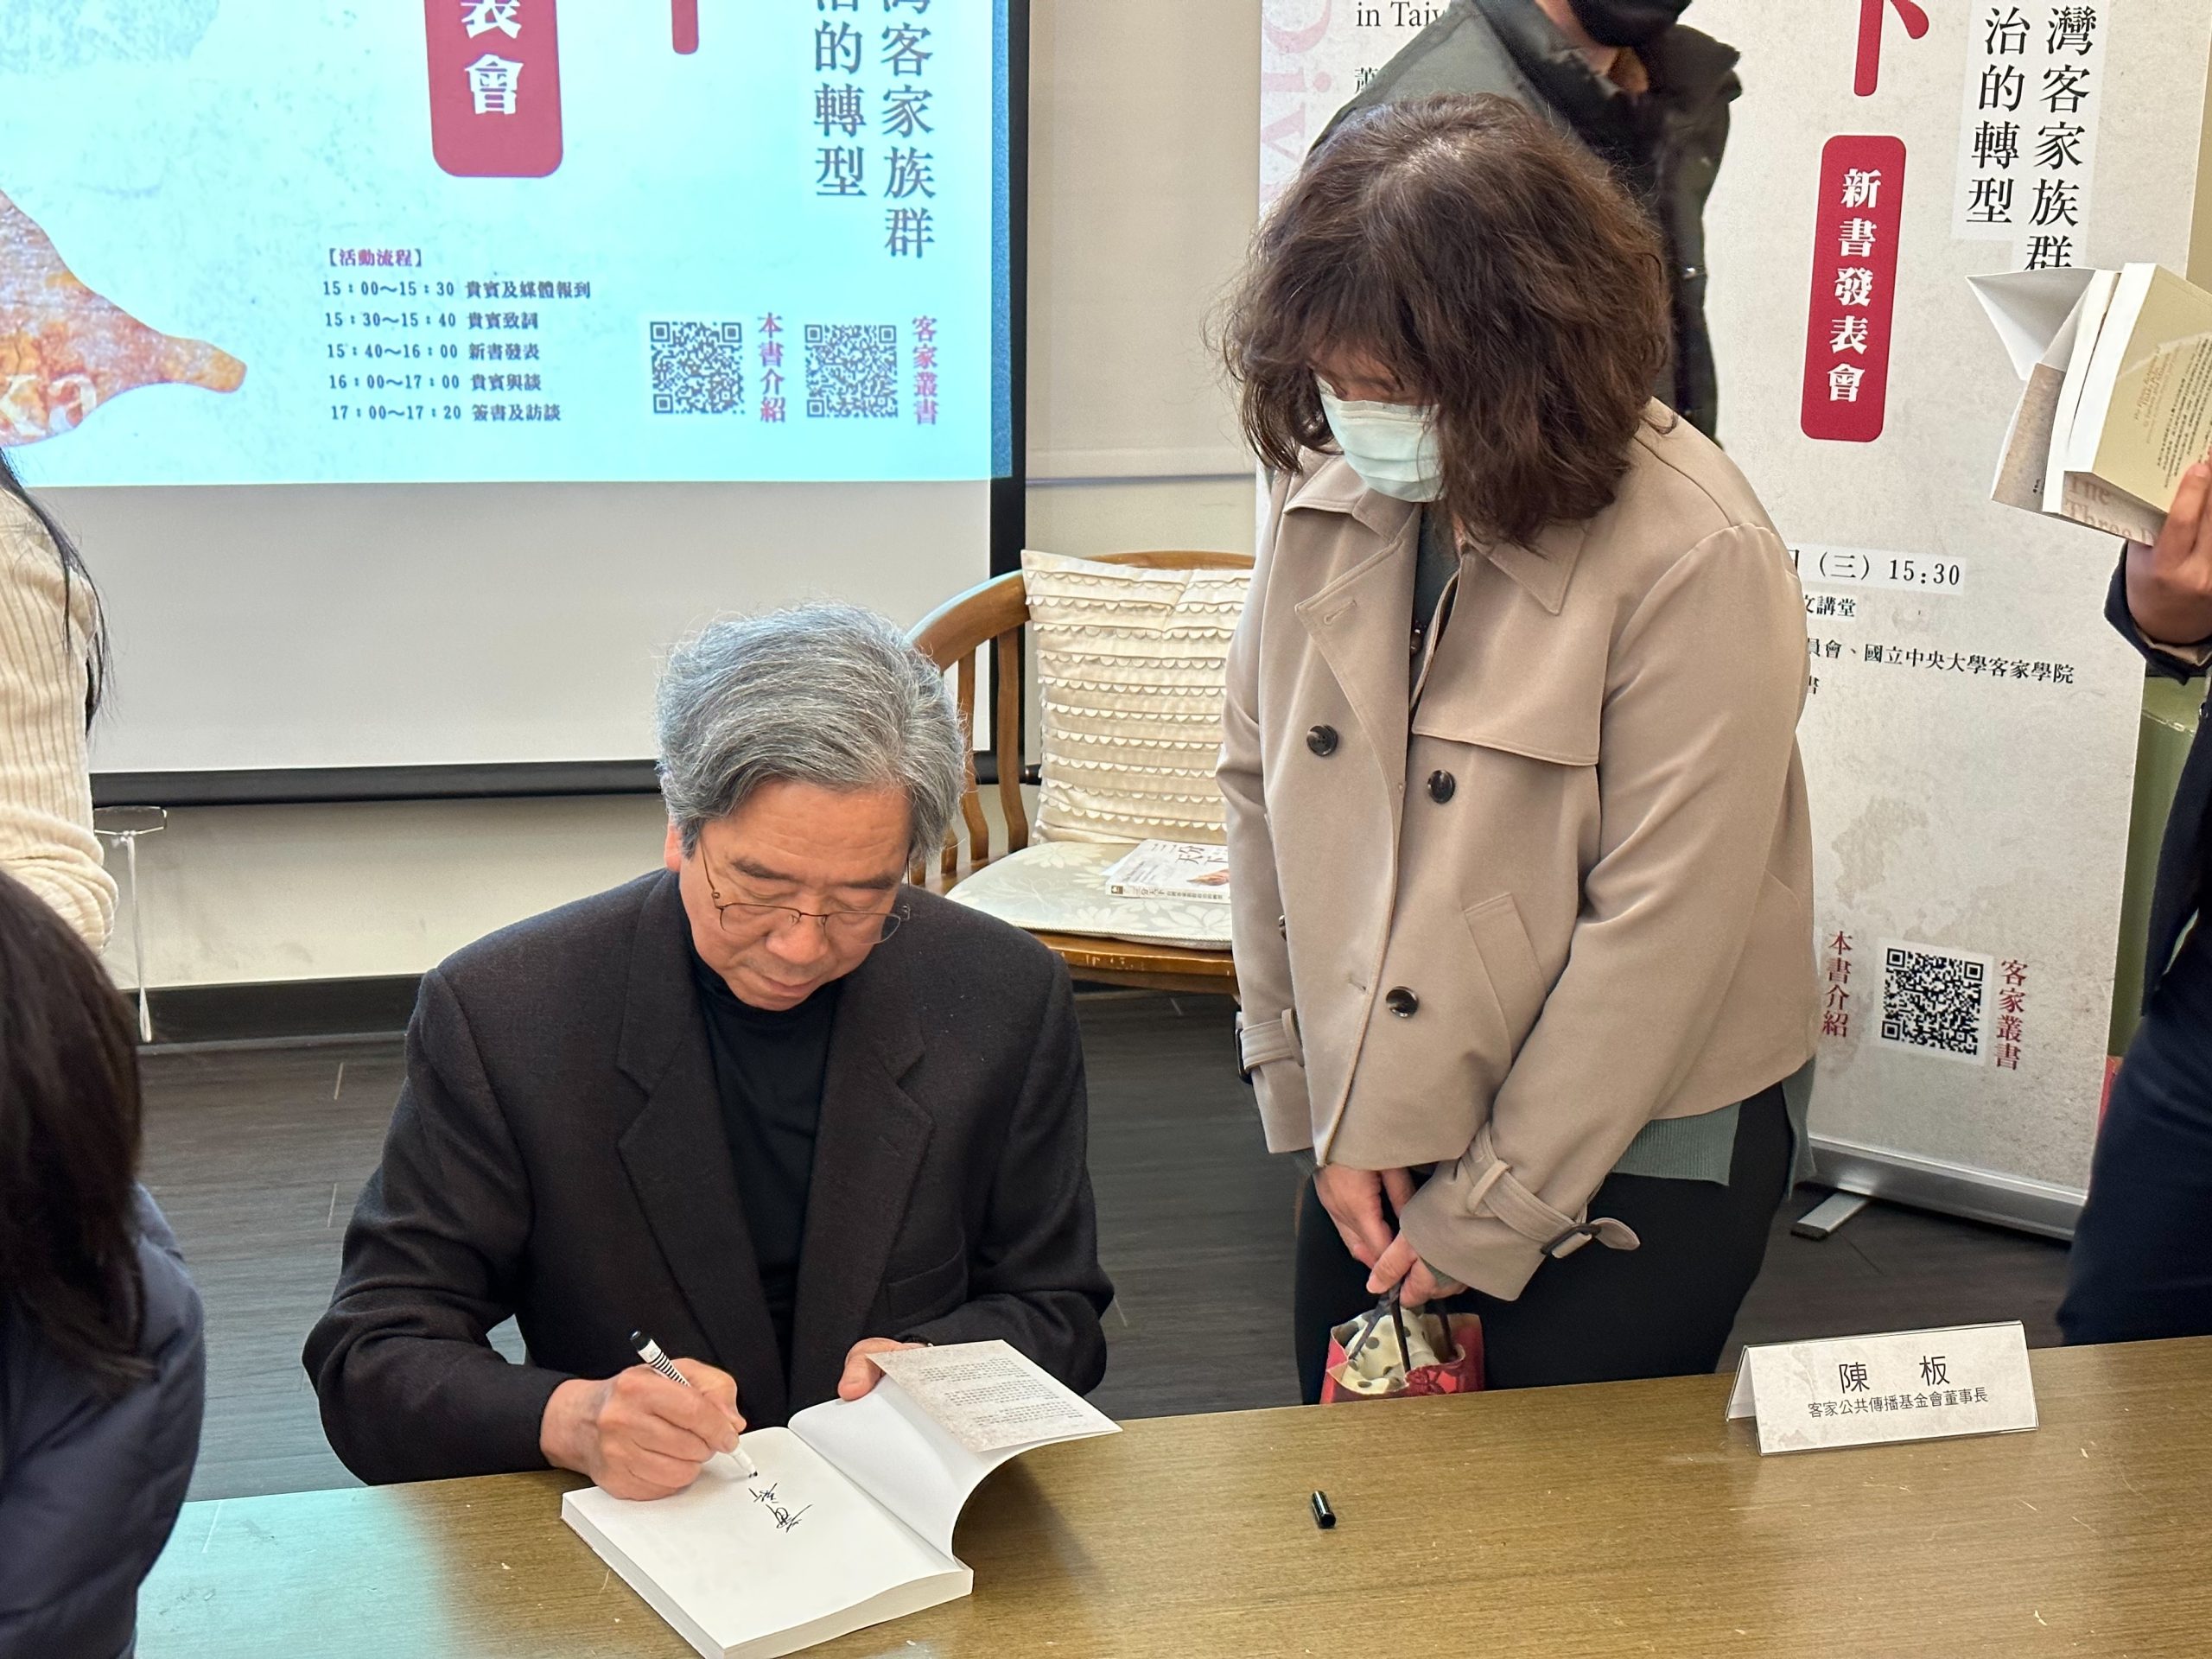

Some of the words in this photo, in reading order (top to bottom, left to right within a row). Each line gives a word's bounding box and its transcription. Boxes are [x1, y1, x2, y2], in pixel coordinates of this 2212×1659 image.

[1356, 2, 1382, 27] in
[813, 0, 868, 198] 的轉型
[880, 0, 937, 258] 客家族群
[1967, 7, 2031, 225] 治的轉型
[1827, 168, 1882, 404] 新書發表會
[758, 312, 785, 423] 本書介紹
[912, 315, 939, 426] 客家叢書
[1889, 558, 1961, 586] 15:30
[1821, 930, 1853, 1038] 本書介紹
[1994, 959, 2028, 1071] 客家叢書
[1808, 1386, 1989, 1418] 客家公共傳播基金會董事長
[1838, 1362, 1871, 1394] 陳
[1918, 1355, 1951, 1387] 板
